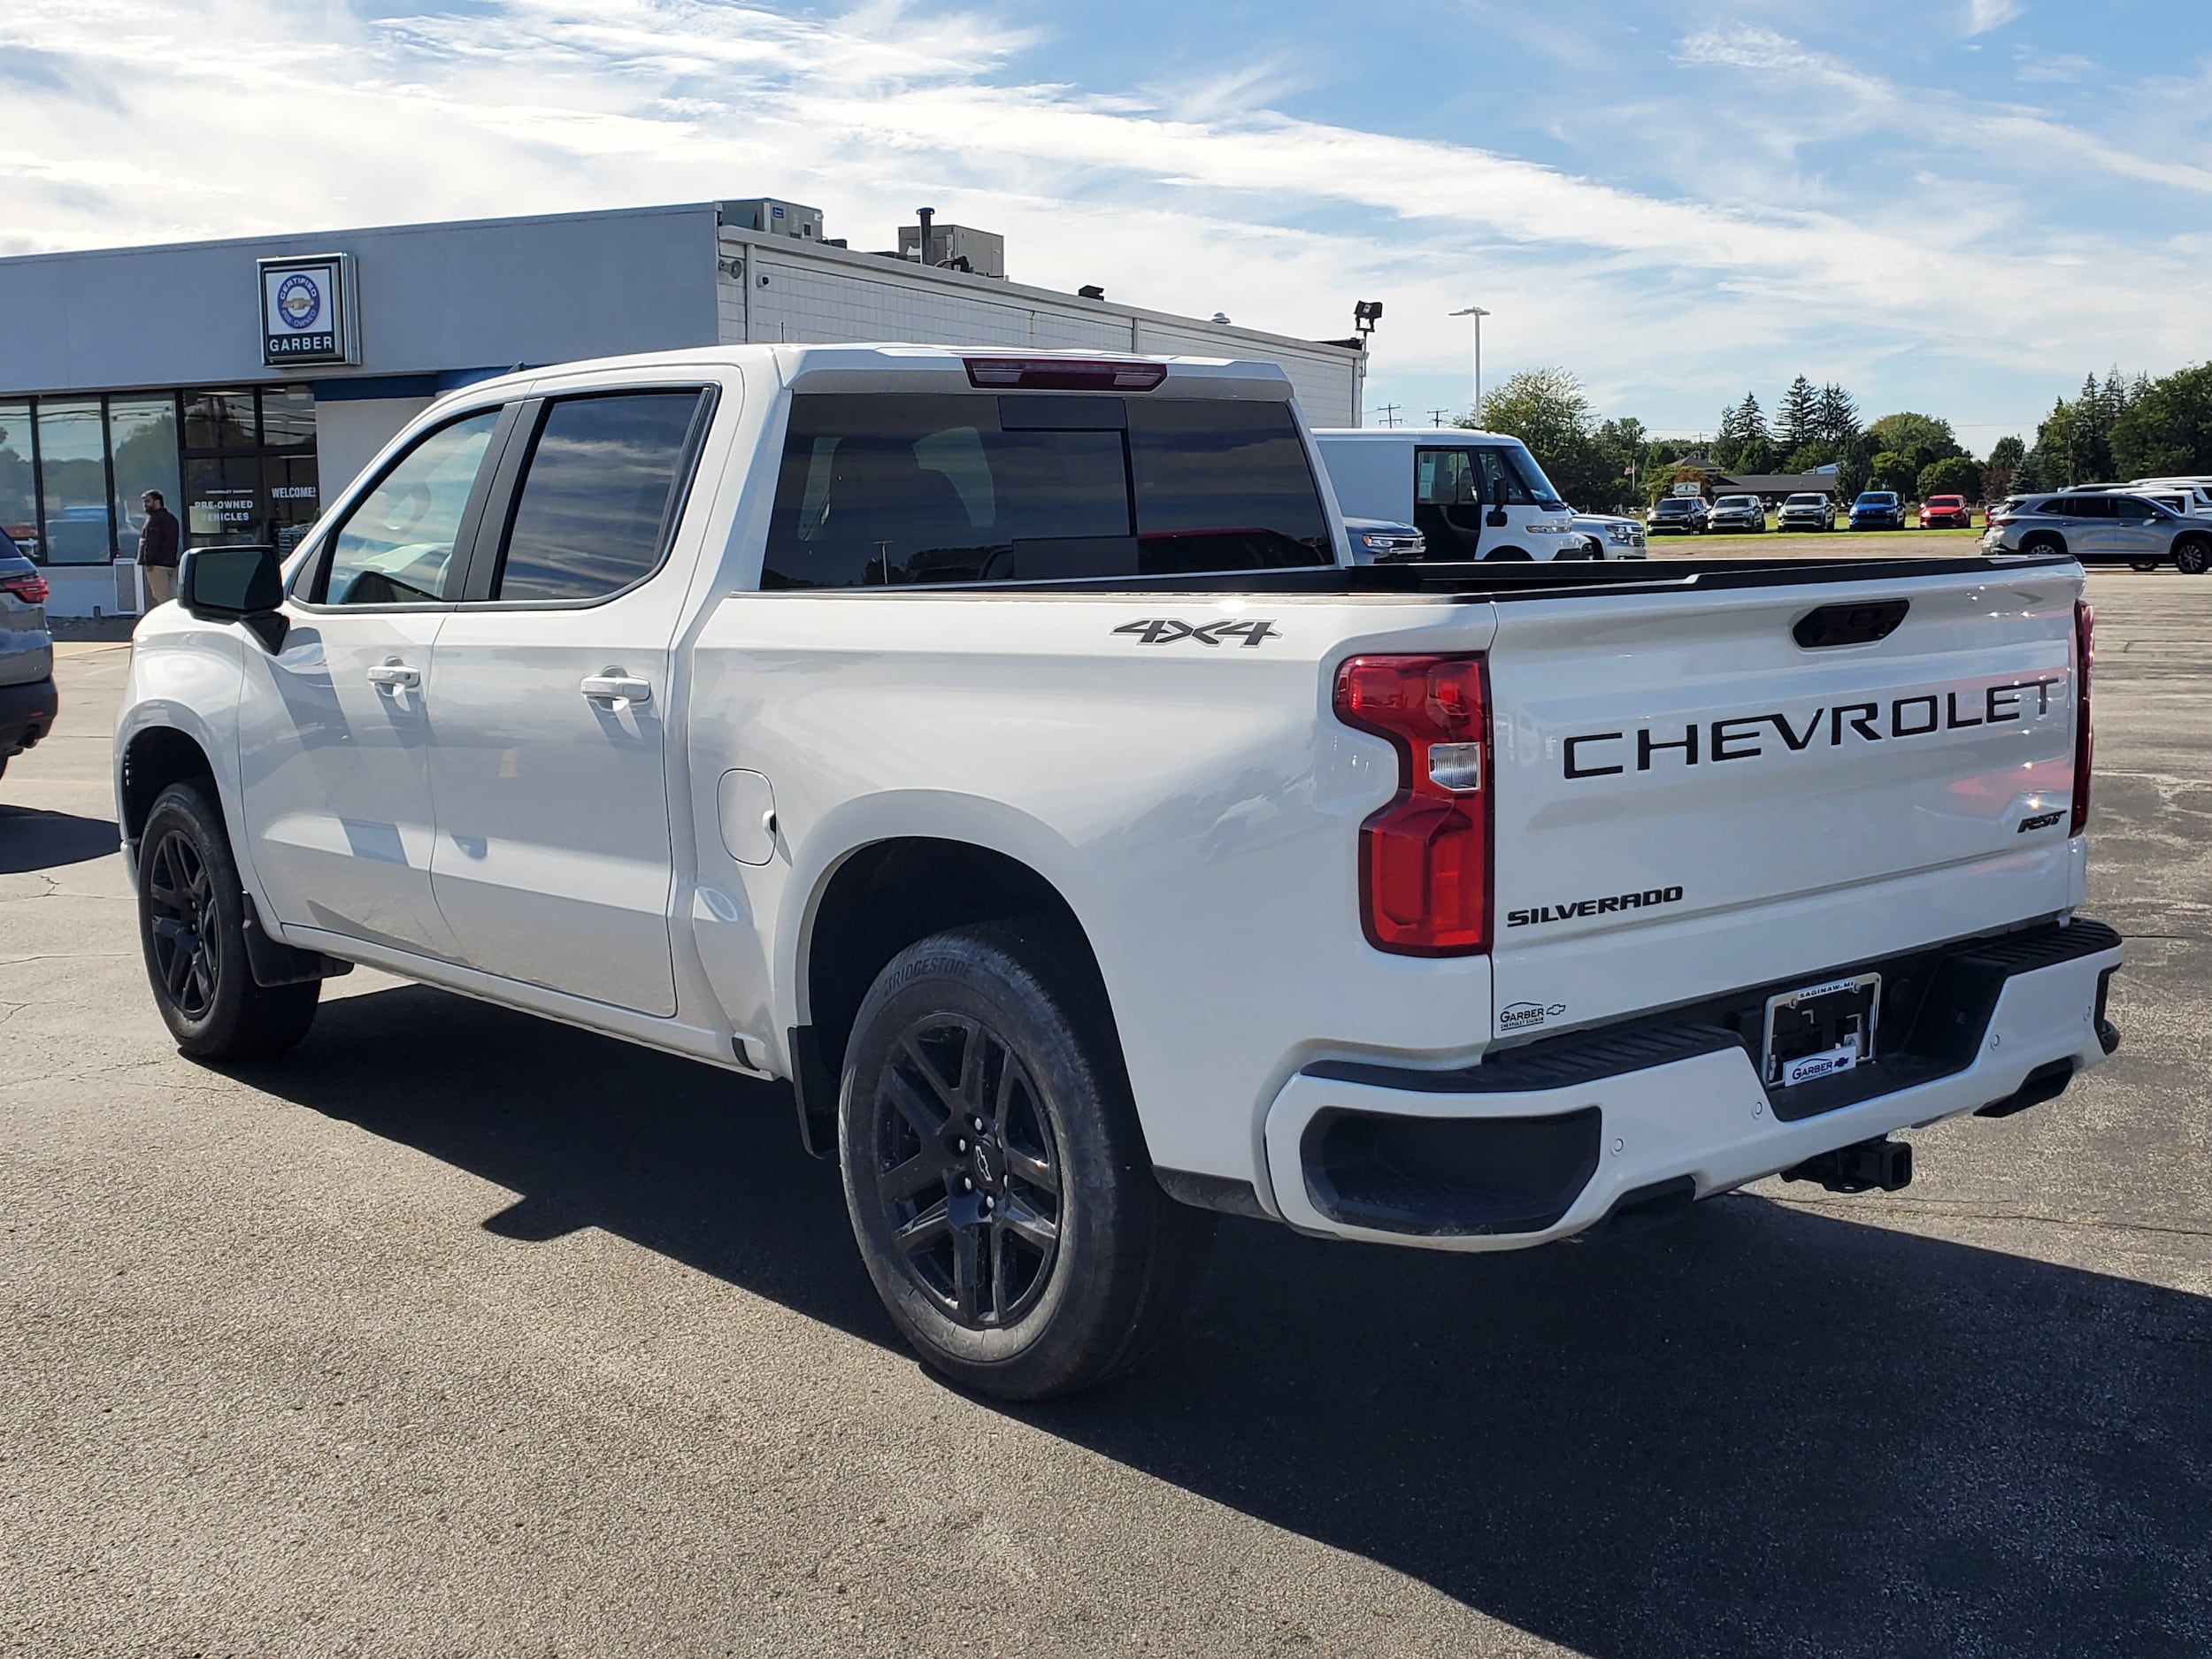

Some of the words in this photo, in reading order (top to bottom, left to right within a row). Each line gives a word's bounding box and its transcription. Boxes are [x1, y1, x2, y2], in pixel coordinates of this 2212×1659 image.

[280, 277, 318, 300] CERTIFIED
[269, 336, 333, 352] GARBER
[271, 487, 317, 498] WELCOME!
[1563, 677, 2059, 780] CHEVROLET
[2016, 810, 2067, 833] RST
[1507, 885, 1684, 928] SILVERADO
[885, 956, 972, 995] BRIDGESTONE
